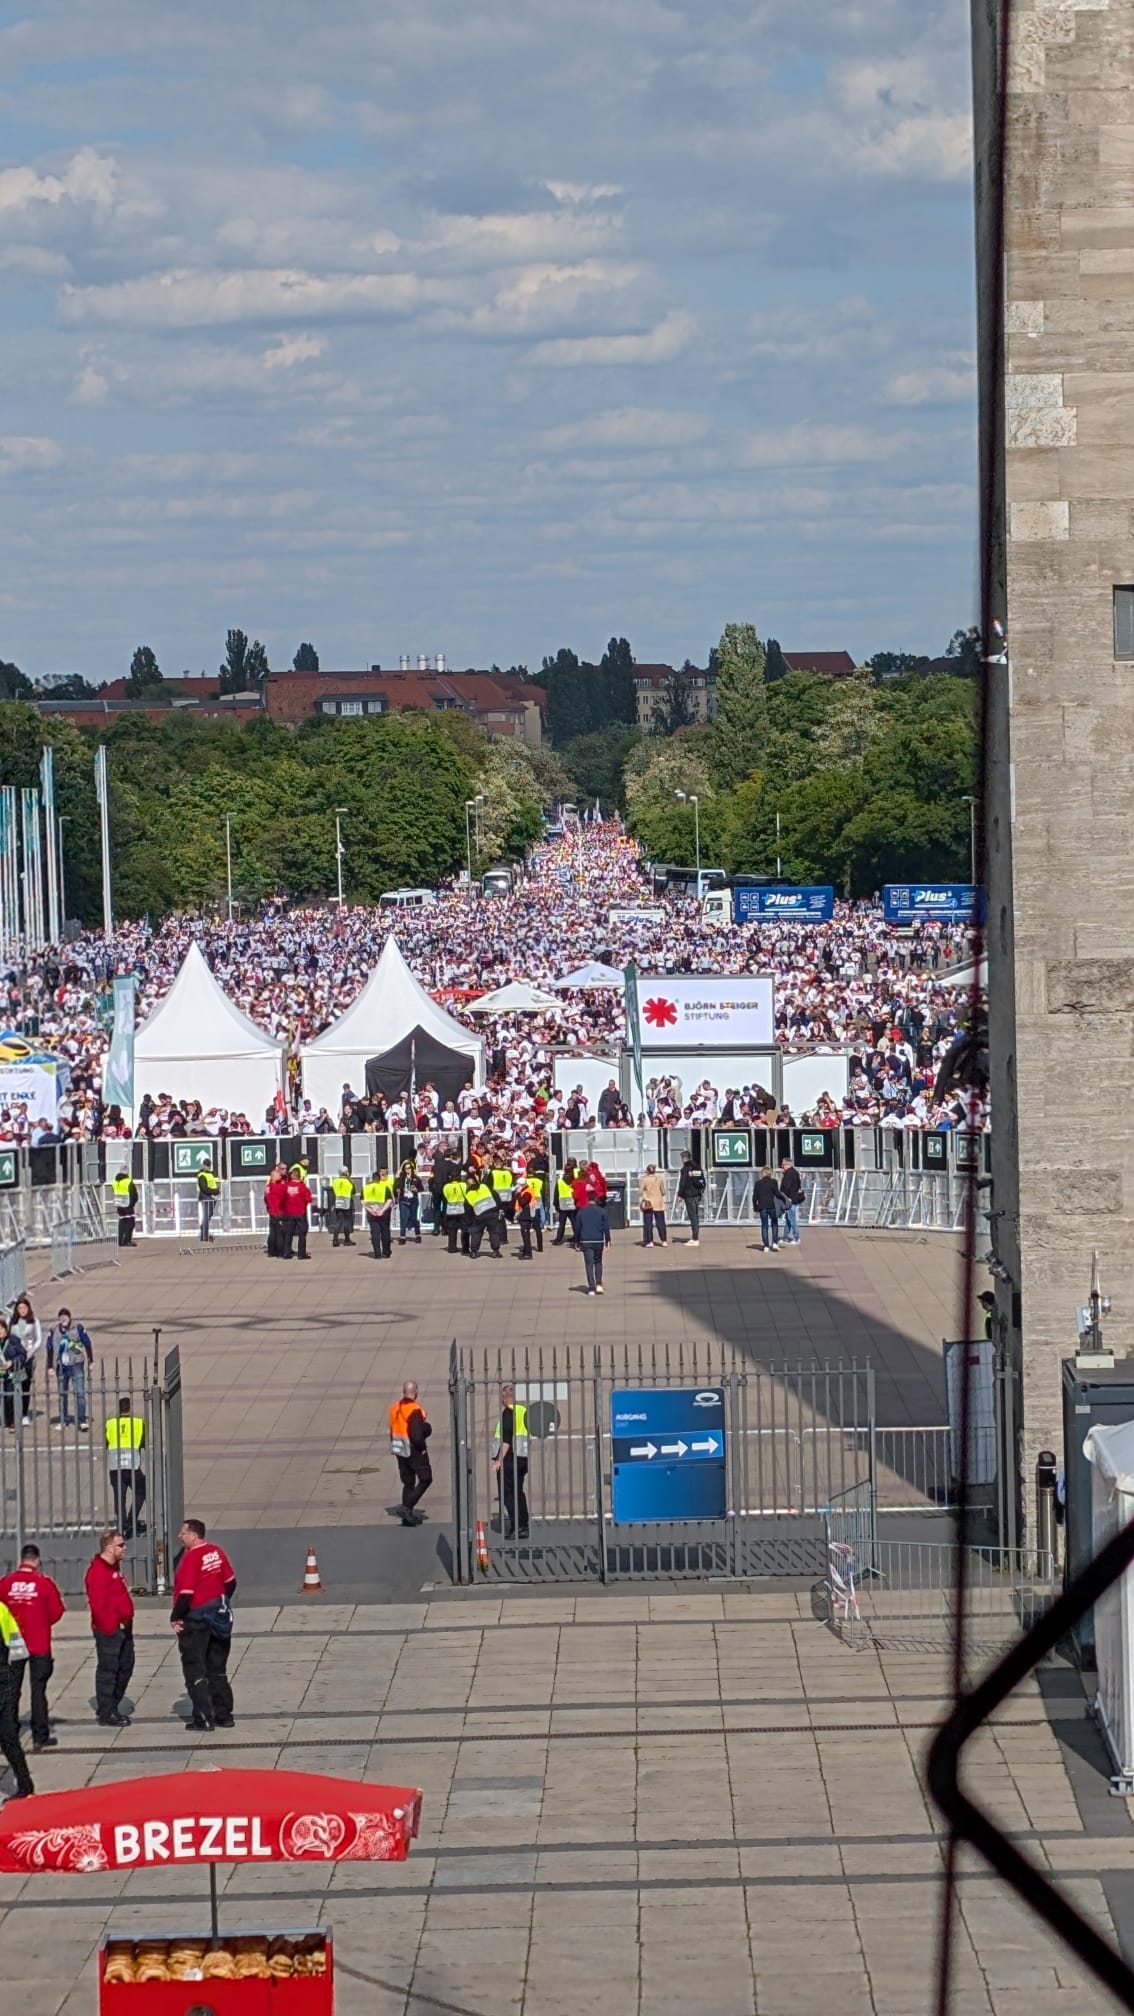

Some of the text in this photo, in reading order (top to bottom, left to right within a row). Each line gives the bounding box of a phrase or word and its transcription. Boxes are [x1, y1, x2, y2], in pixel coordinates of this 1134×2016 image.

[764, 893, 798, 905] Plus
[914, 890, 947, 902] Plus
[684, 1001, 759, 1010] BJÖRN STEIGER
[684, 1012, 730, 1021] STIFTUNG
[202, 1550, 219, 1565] SDS
[114, 1816, 272, 1864] BREZEL
